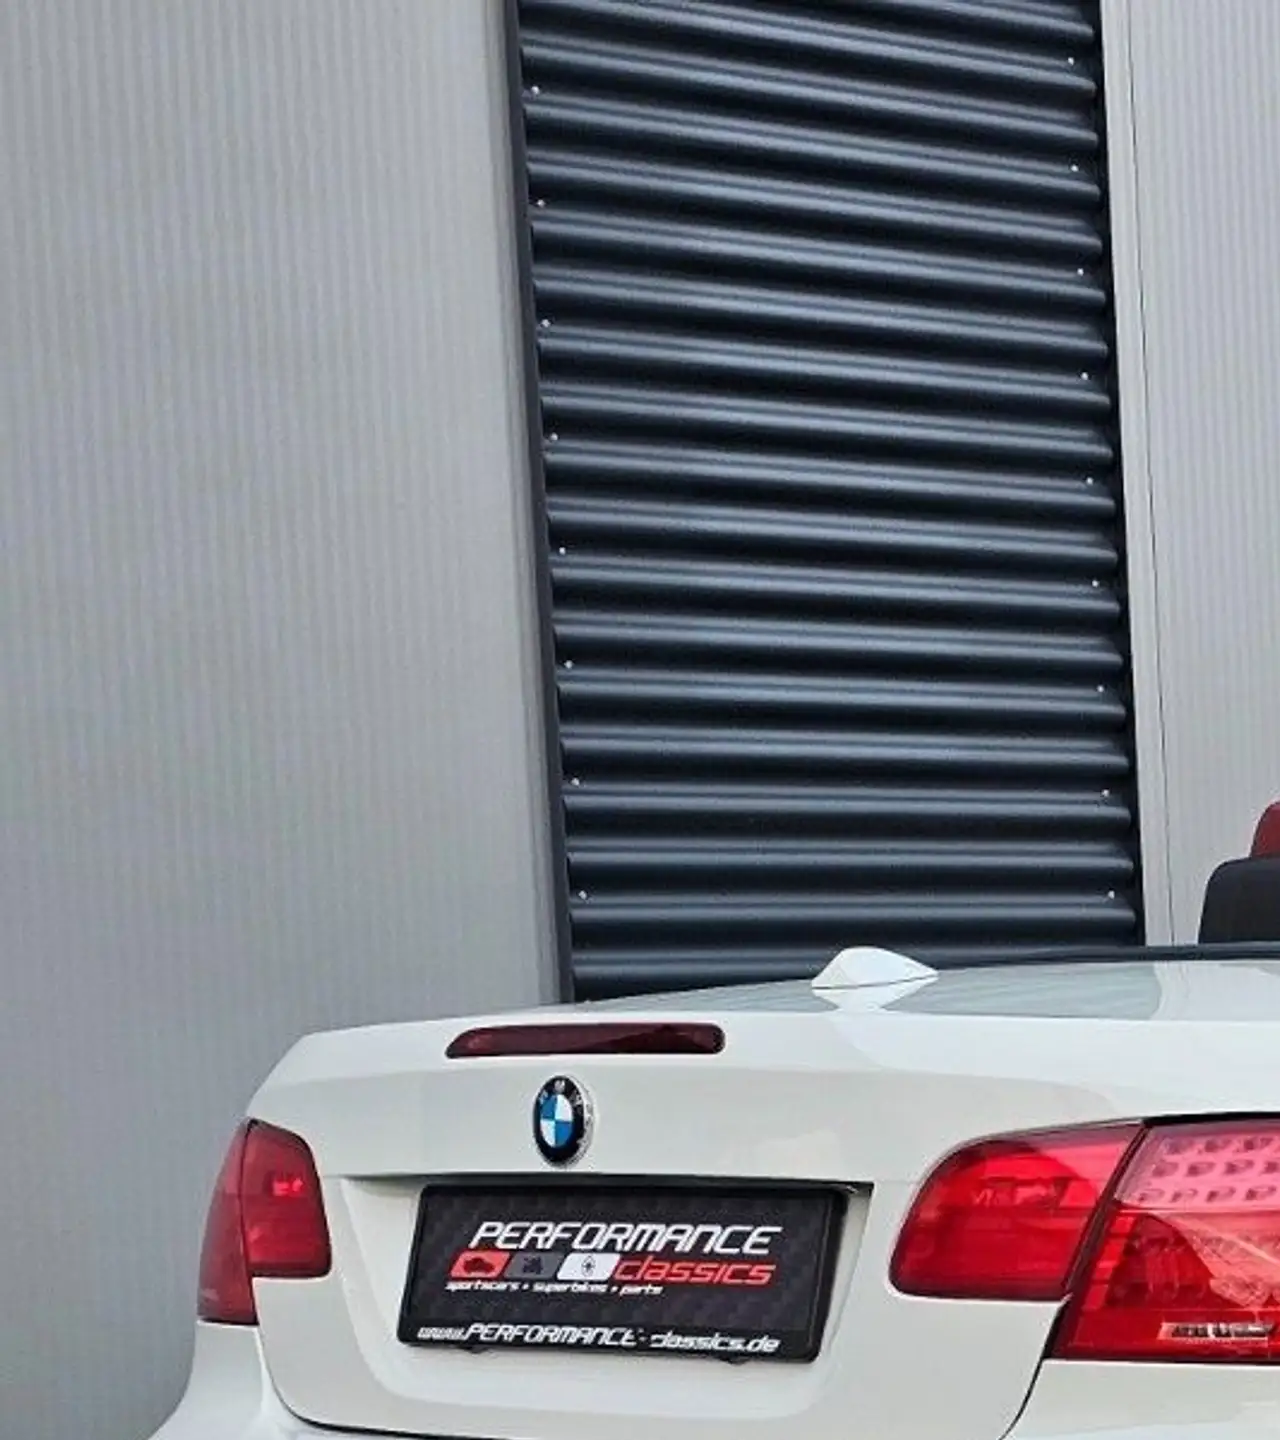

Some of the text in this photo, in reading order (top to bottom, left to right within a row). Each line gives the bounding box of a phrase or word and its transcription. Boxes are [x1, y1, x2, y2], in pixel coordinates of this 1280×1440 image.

[469, 1220, 782, 1255] PERFORMANCE
[613, 1253, 777, 1285] classics
[619, 1284, 663, 1297] parts
